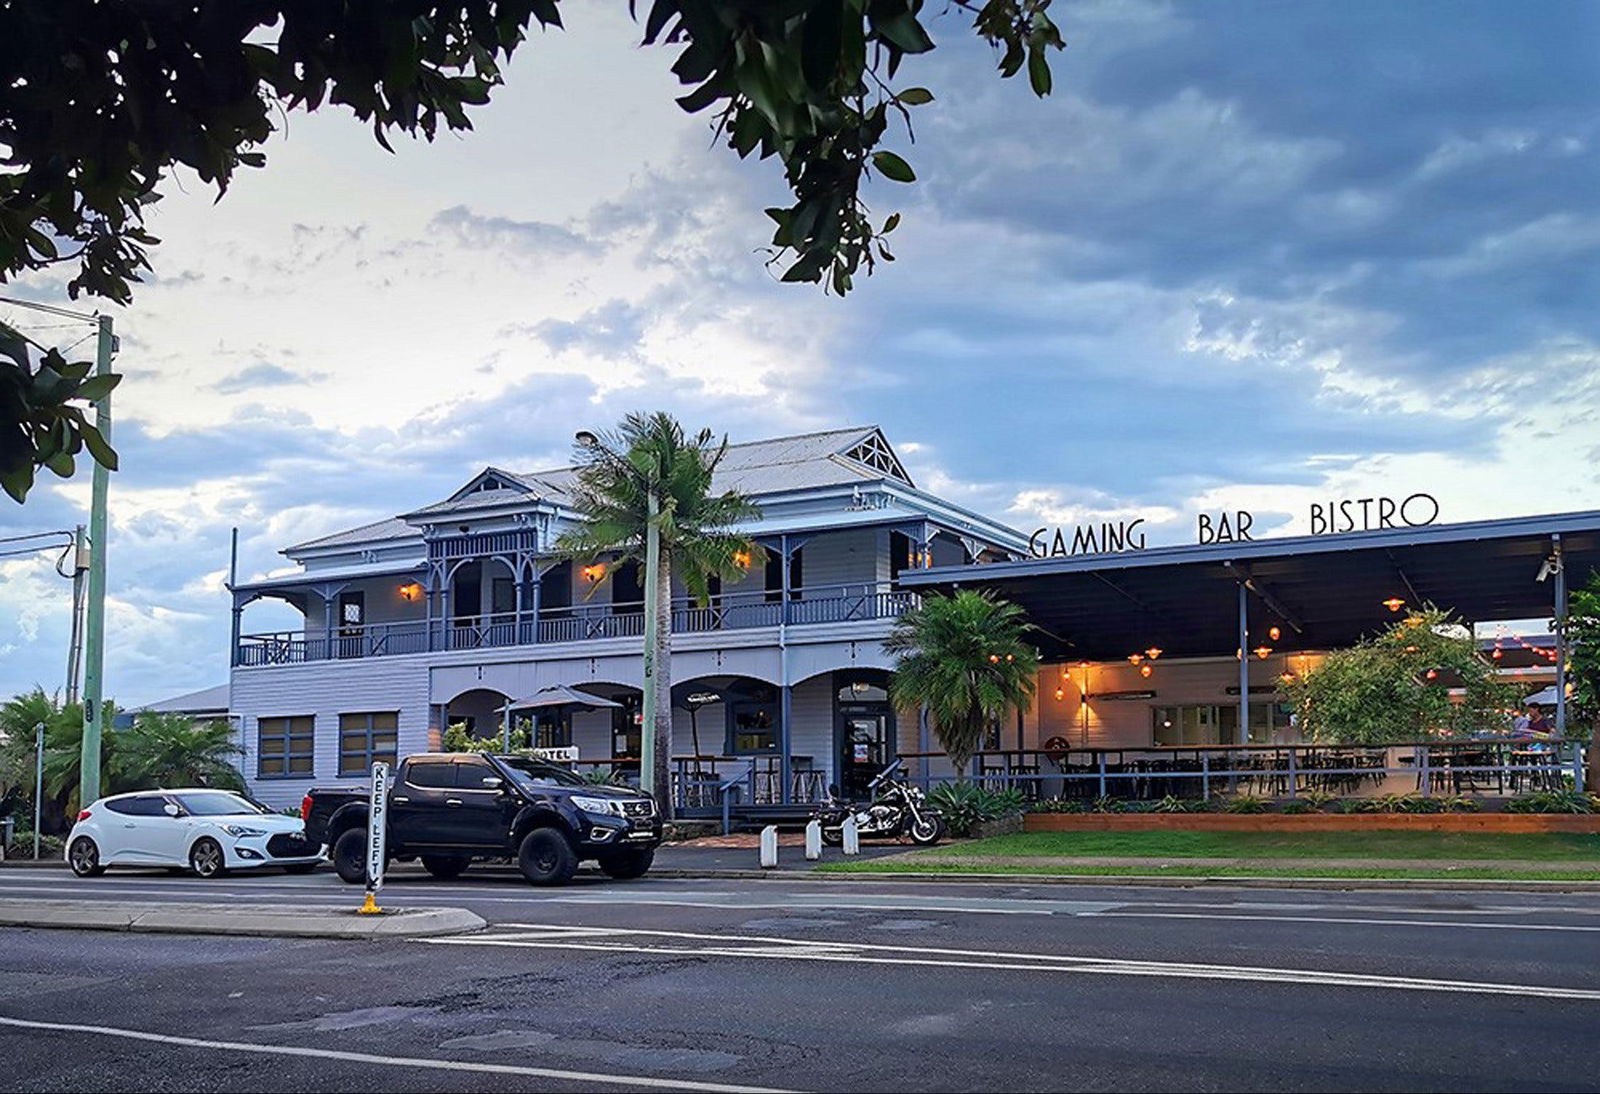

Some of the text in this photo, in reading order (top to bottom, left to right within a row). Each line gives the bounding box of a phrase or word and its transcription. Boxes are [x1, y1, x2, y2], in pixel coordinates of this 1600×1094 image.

[1029, 494, 1439, 558] GAMING BAR BISTRO
[371, 767, 384, 874] KEEP LEFT
